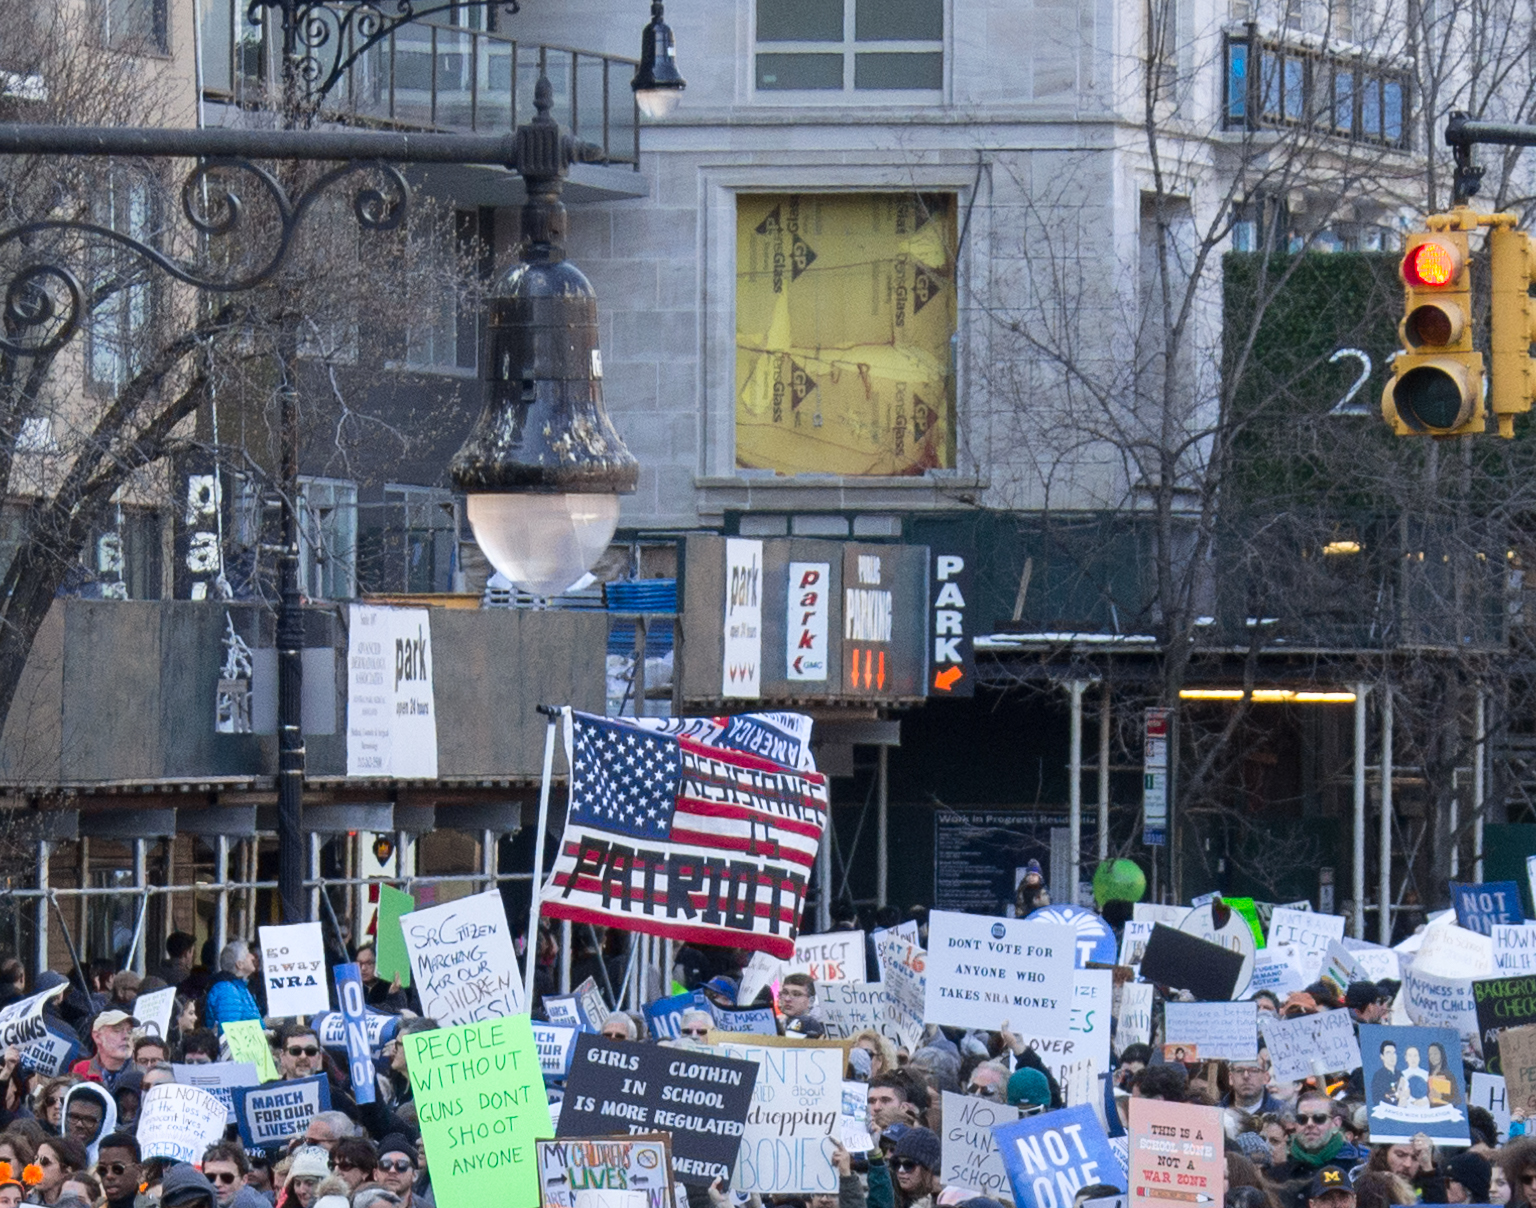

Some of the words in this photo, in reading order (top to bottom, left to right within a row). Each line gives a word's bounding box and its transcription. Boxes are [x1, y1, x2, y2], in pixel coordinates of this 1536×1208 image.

[731, 553, 758, 617] park
[798, 569, 819, 650] park
[846, 588, 893, 642] PARKING
[934, 555, 965, 664] PARK
[395, 623, 427, 693] park
[1463, 892, 1506, 913] NOT
[266, 947, 290, 961] go
[988, 942, 1021, 956] VOTE
[1028, 945, 1054, 958] FOR
[268, 960, 322, 977] away
[457, 960, 490, 982] OUR
[809, 961, 846, 981] KIDS
[955, 964, 1007, 980] ANYONE
[1016, 970, 1046, 984] WHO
[269, 973, 319, 991] NRA
[939, 987, 981, 1002] TAKES
[984, 990, 1010, 1005] NRA
[1013, 995, 1058, 1010] MONEY
[414, 1024, 505, 1064] PEOPLE
[586, 1046, 640, 1071] GIRLS
[412, 1050, 522, 1091] WITHOUT
[176, 1087, 204, 1105] NOT
[251, 1090, 305, 1110] MARCH
[621, 1077, 647, 1096] IN
[661, 1085, 725, 1110] SCHOOL
[254, 1106, 285, 1123] FOR
[285, 1102, 315, 1118] OUR
[419, 1096, 466, 1125] GUNS
[573, 1095, 596, 1111] IS
[601, 1099, 648, 1122] MORE
[653, 1108, 745, 1137] REGULATED
[959, 1100, 996, 1128] NO
[257, 1119, 298, 1138] LIVES
[448, 1115, 519, 1149] SHOOT
[1151, 1124, 1176, 1138] THIS
[1179, 1126, 1192, 1138] IS
[1194, 1129, 1204, 1140] A
[966, 1152, 990, 1168] IN
[1015, 1123, 1082, 1175] NOT
[1139, 1139, 1179, 1155] SCHOOL
[1182, 1142, 1214, 1159] ZONE
[451, 1145, 525, 1177] ANYONE
[739, 1136, 840, 1193] BODIES
[1157, 1154, 1181, 1169] NOT
[1185, 1158, 1196, 1170] A
[568, 1168, 628, 1191] LIVES
[1142, 1169, 1173, 1184] WAR
[1176, 1173, 1208, 1188] ZONE
